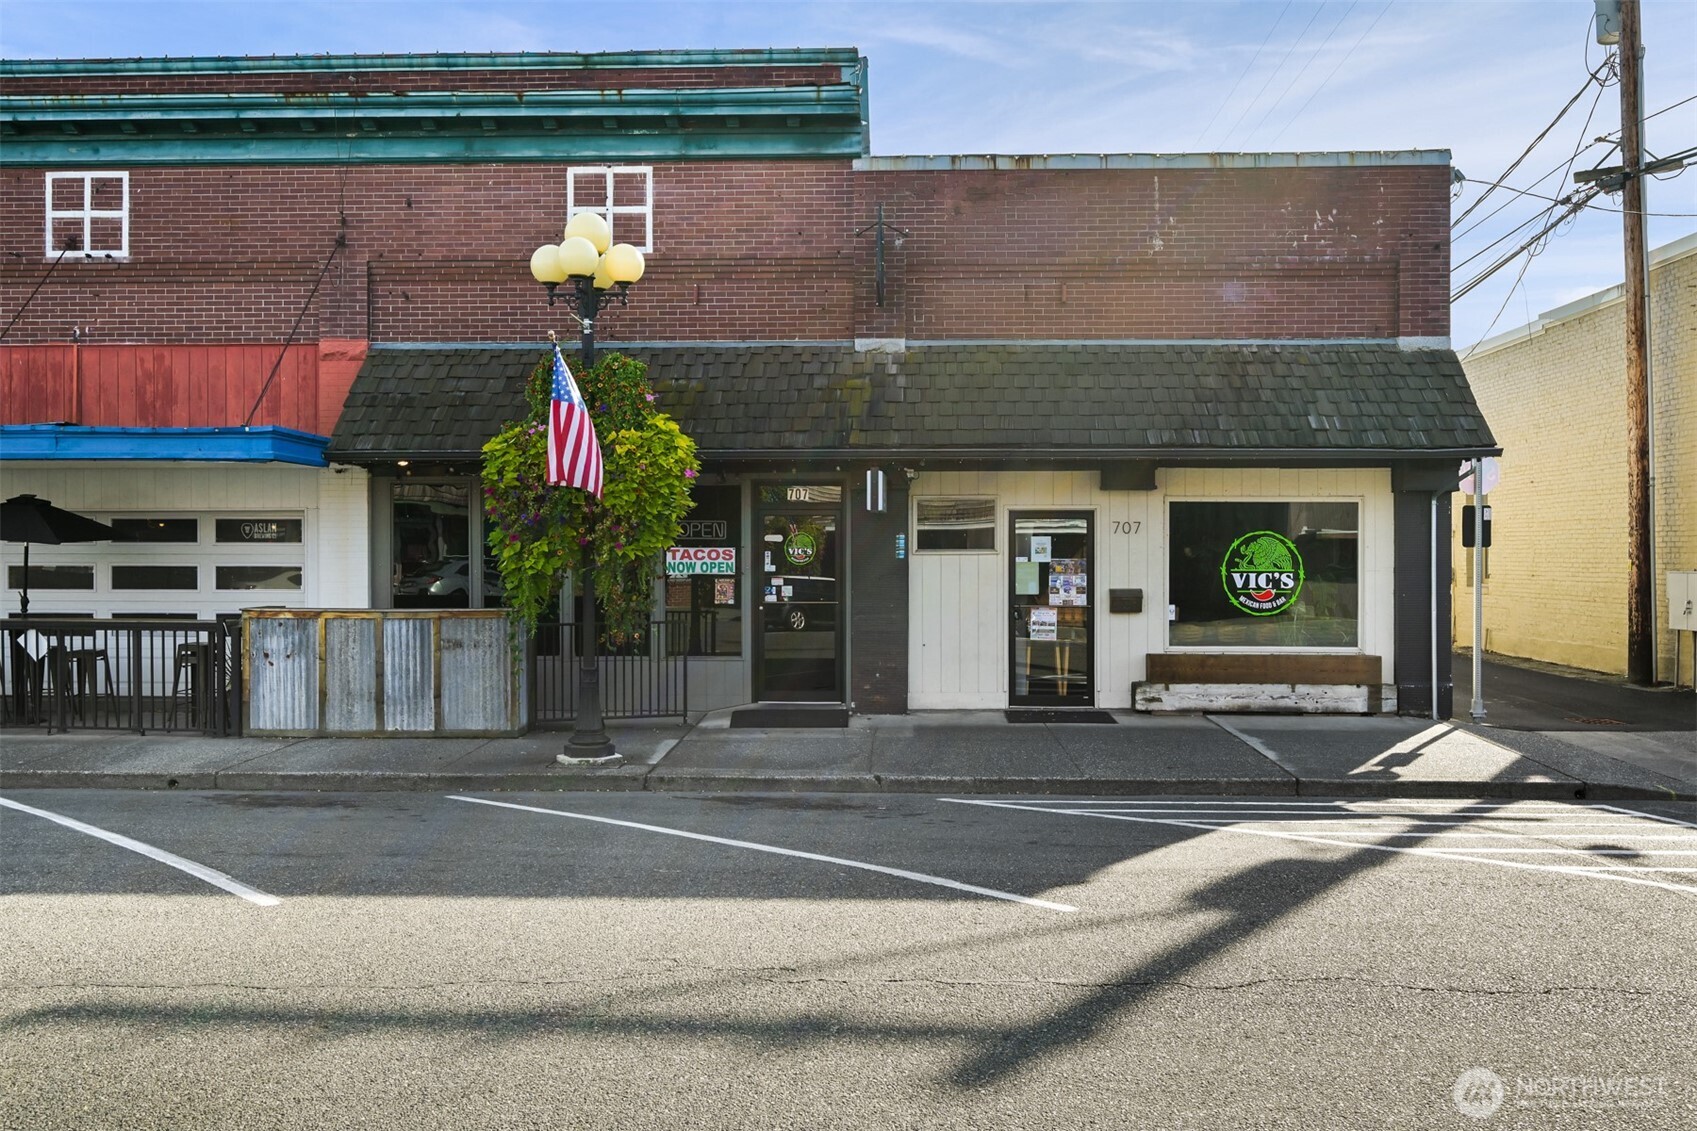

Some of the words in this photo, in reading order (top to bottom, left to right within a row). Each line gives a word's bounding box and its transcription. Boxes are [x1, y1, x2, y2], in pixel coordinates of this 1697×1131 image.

[789, 489, 808, 500] 707
[254, 523, 277, 533] ASLAN
[679, 523, 724, 537] OPEN
[1112, 521, 1141, 535] 707
[670, 549, 733, 560] TACOS
[668, 562, 696, 573] NOW
[700, 562, 734, 573] OPEN
[1231, 572, 1294, 589] VIC'S
[1239, 595, 1259, 608] MEXICAN
[1276, 596, 1287, 606] BAR
